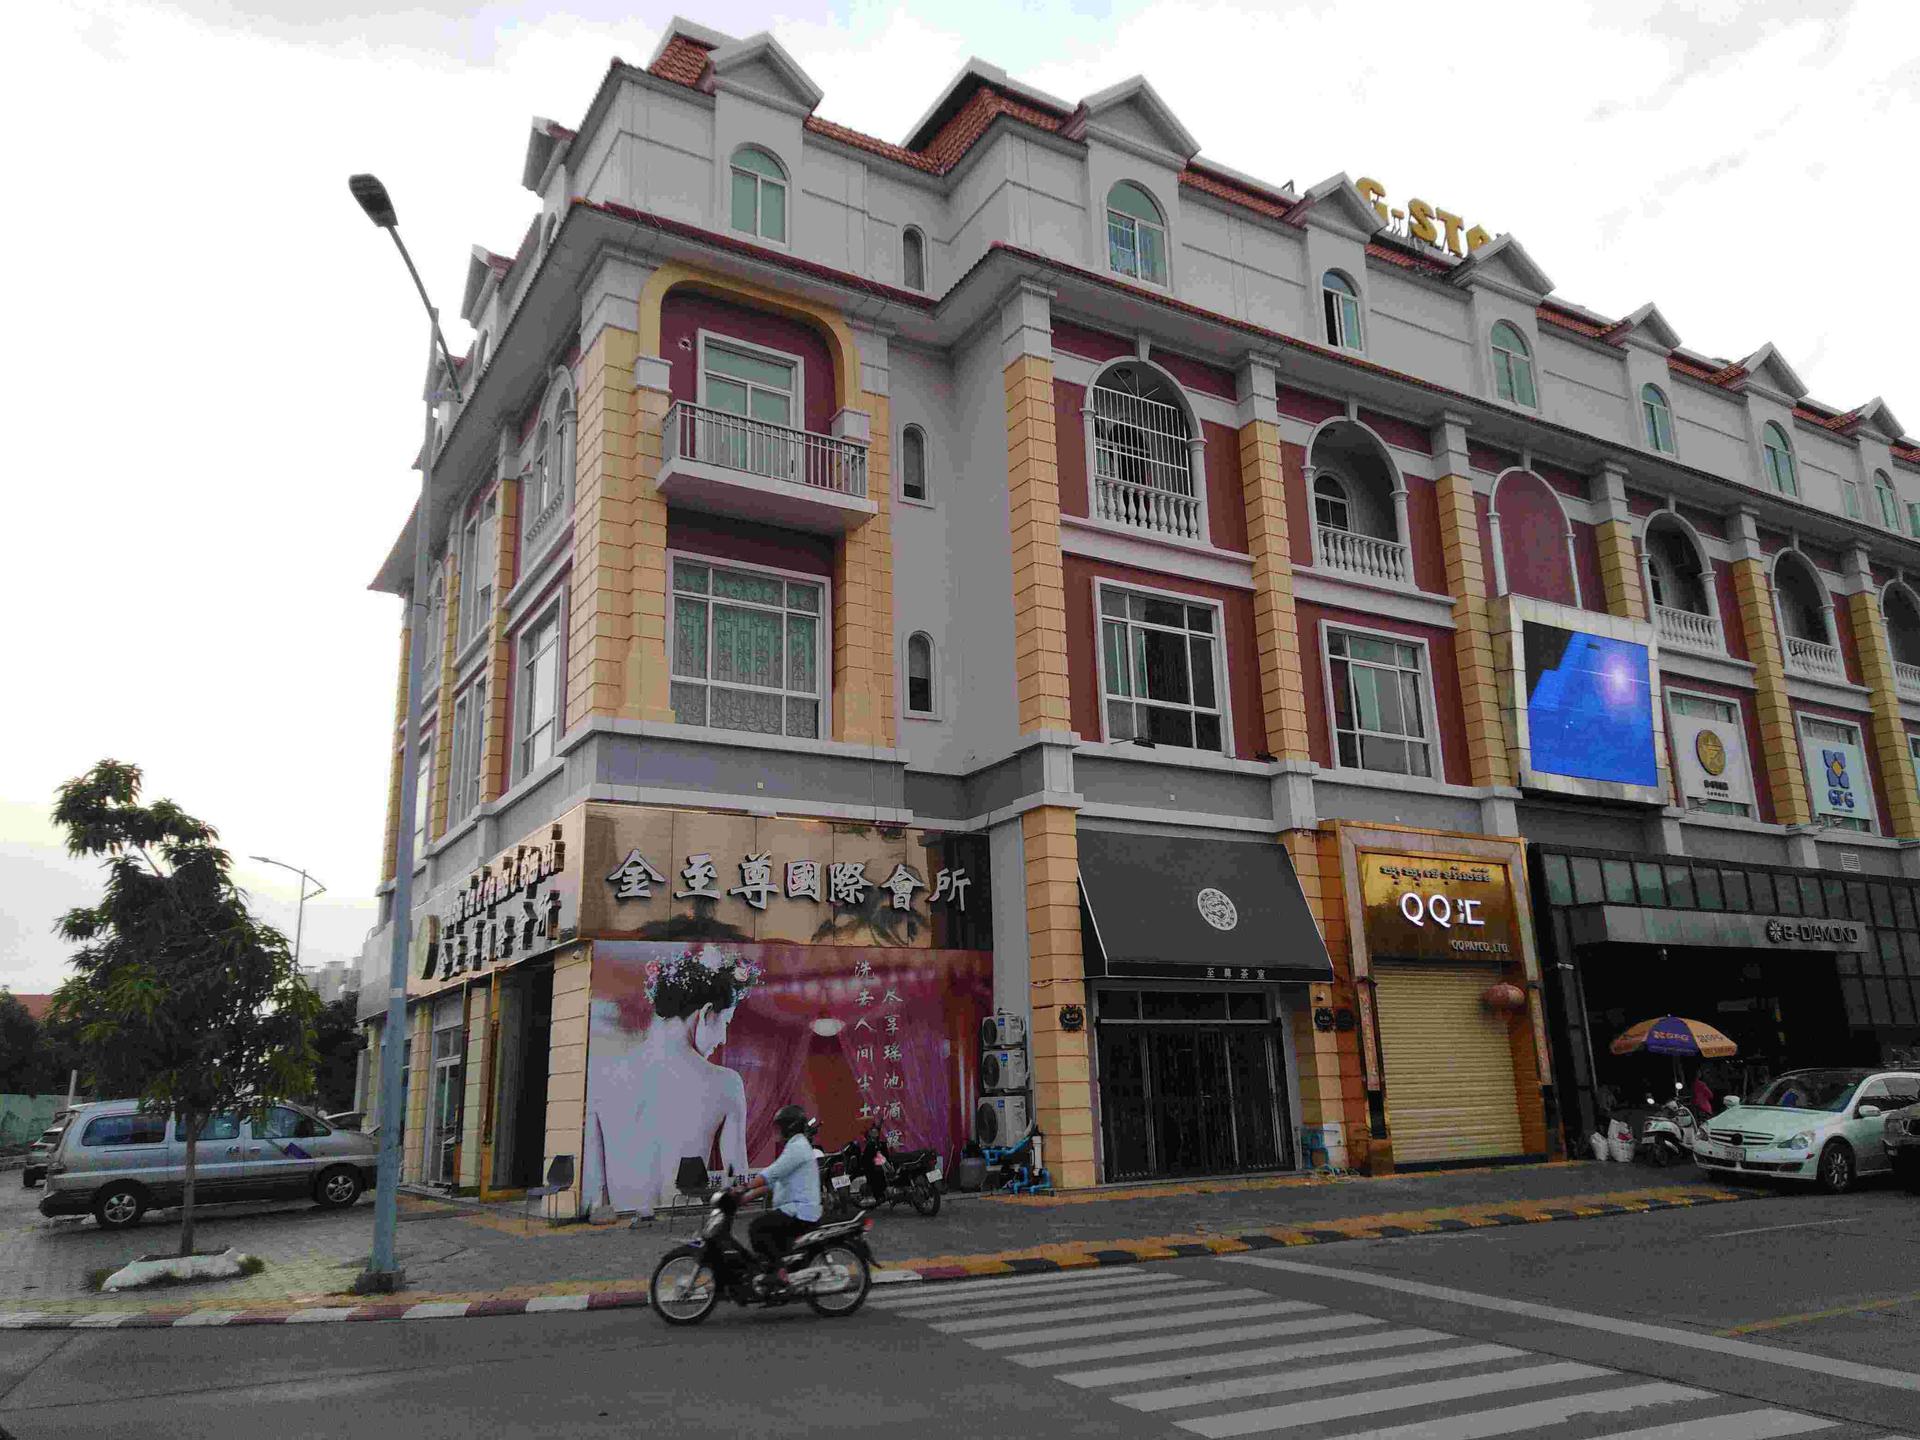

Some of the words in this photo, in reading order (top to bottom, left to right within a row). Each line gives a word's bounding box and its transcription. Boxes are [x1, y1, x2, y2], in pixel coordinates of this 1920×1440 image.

[606, 848, 972, 913] 金至尊國際會所
